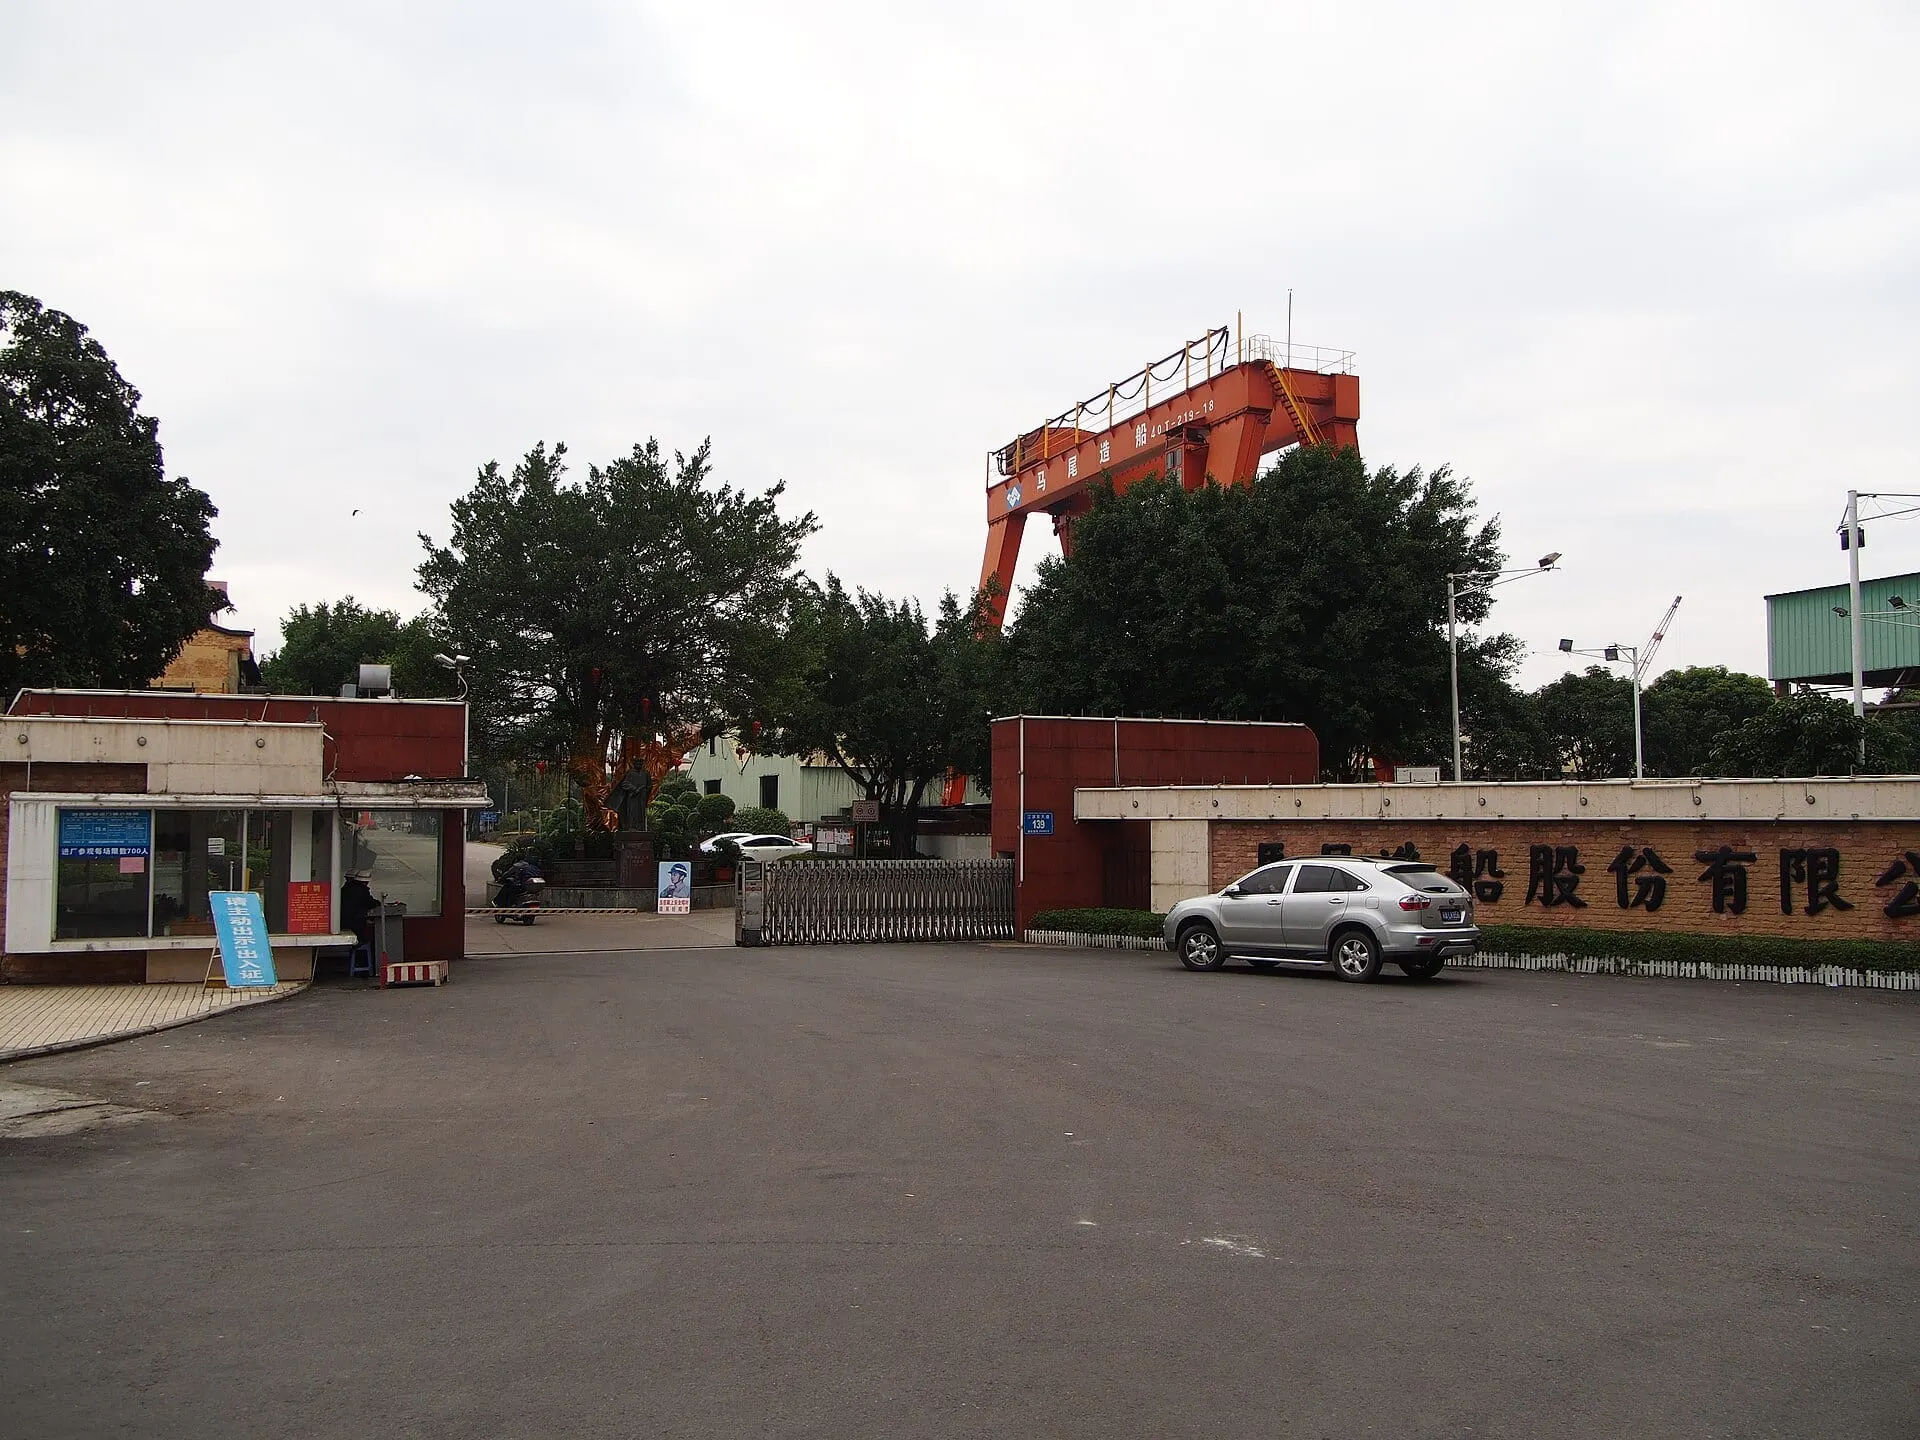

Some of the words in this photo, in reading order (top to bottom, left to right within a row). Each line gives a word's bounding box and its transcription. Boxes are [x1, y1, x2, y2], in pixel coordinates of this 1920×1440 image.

[1036, 422, 1148, 491] 马尾造船
[1032, 819, 1046, 829] 139
